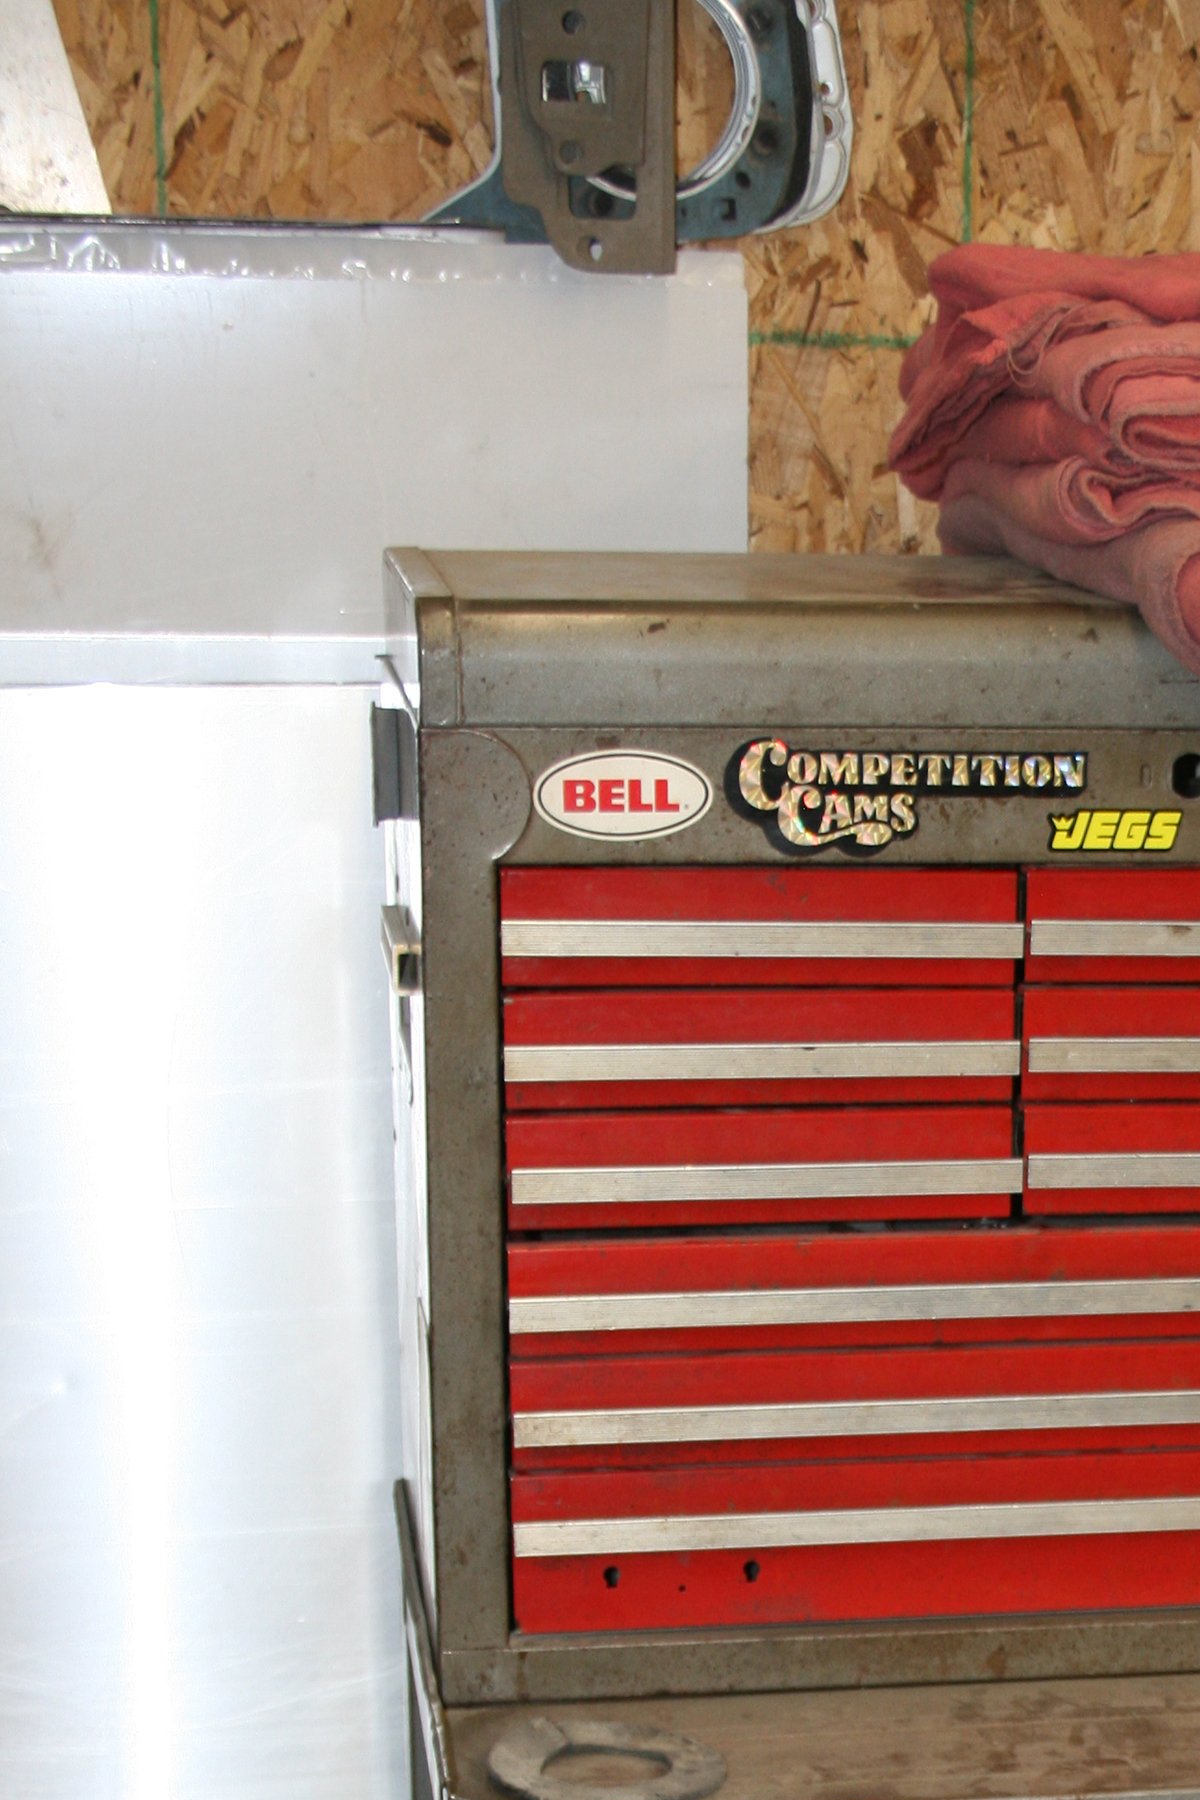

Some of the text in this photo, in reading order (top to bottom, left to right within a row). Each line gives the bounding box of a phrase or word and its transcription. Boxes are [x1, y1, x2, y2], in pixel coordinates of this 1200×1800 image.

[563, 779, 680, 813] BELL
[739, 738, 1084, 811] COMPETITION
[778, 784, 916, 846] CAMS
[1052, 810, 1182, 850] JEGS
